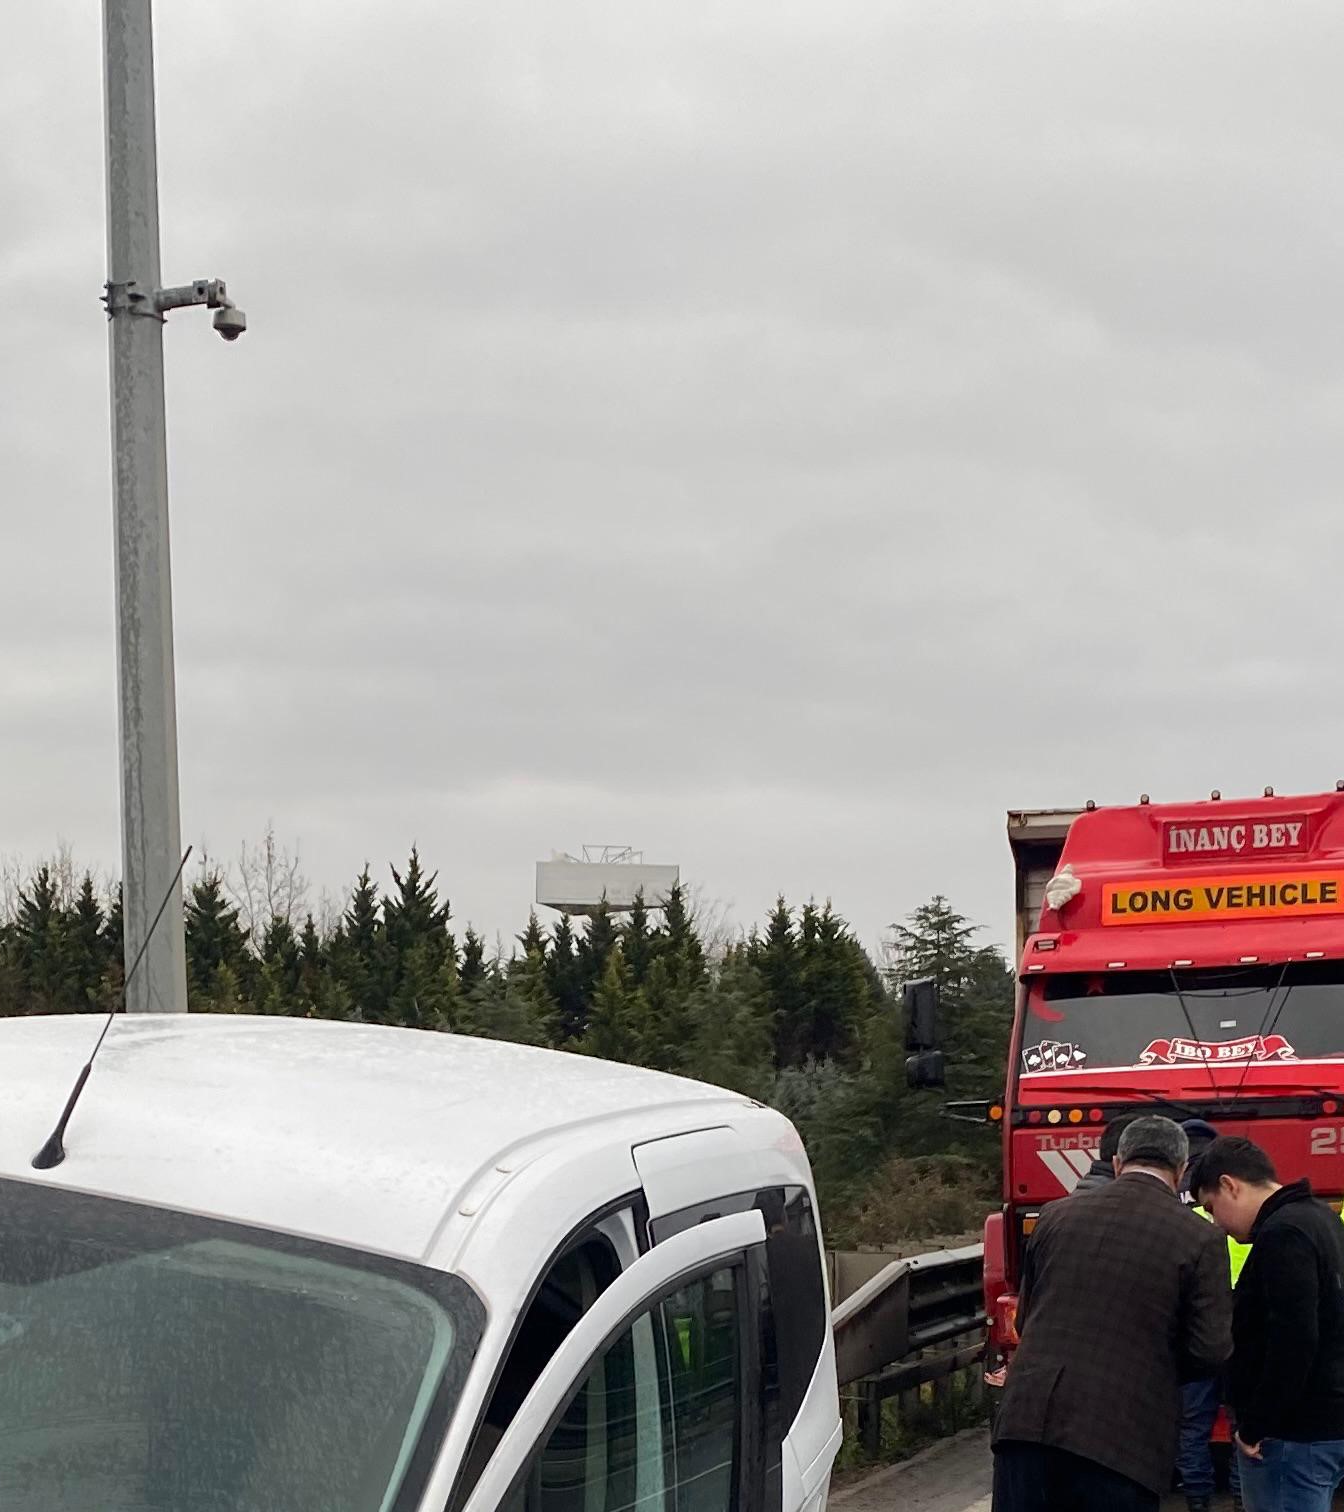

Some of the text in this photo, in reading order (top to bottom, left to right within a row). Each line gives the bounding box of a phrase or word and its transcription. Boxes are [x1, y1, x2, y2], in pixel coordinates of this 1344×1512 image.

[1252, 822, 1303, 849] BEY
[1111, 881, 1338, 914] LONG VEHICLE
[1216, 1039, 1257, 1059] BEY
